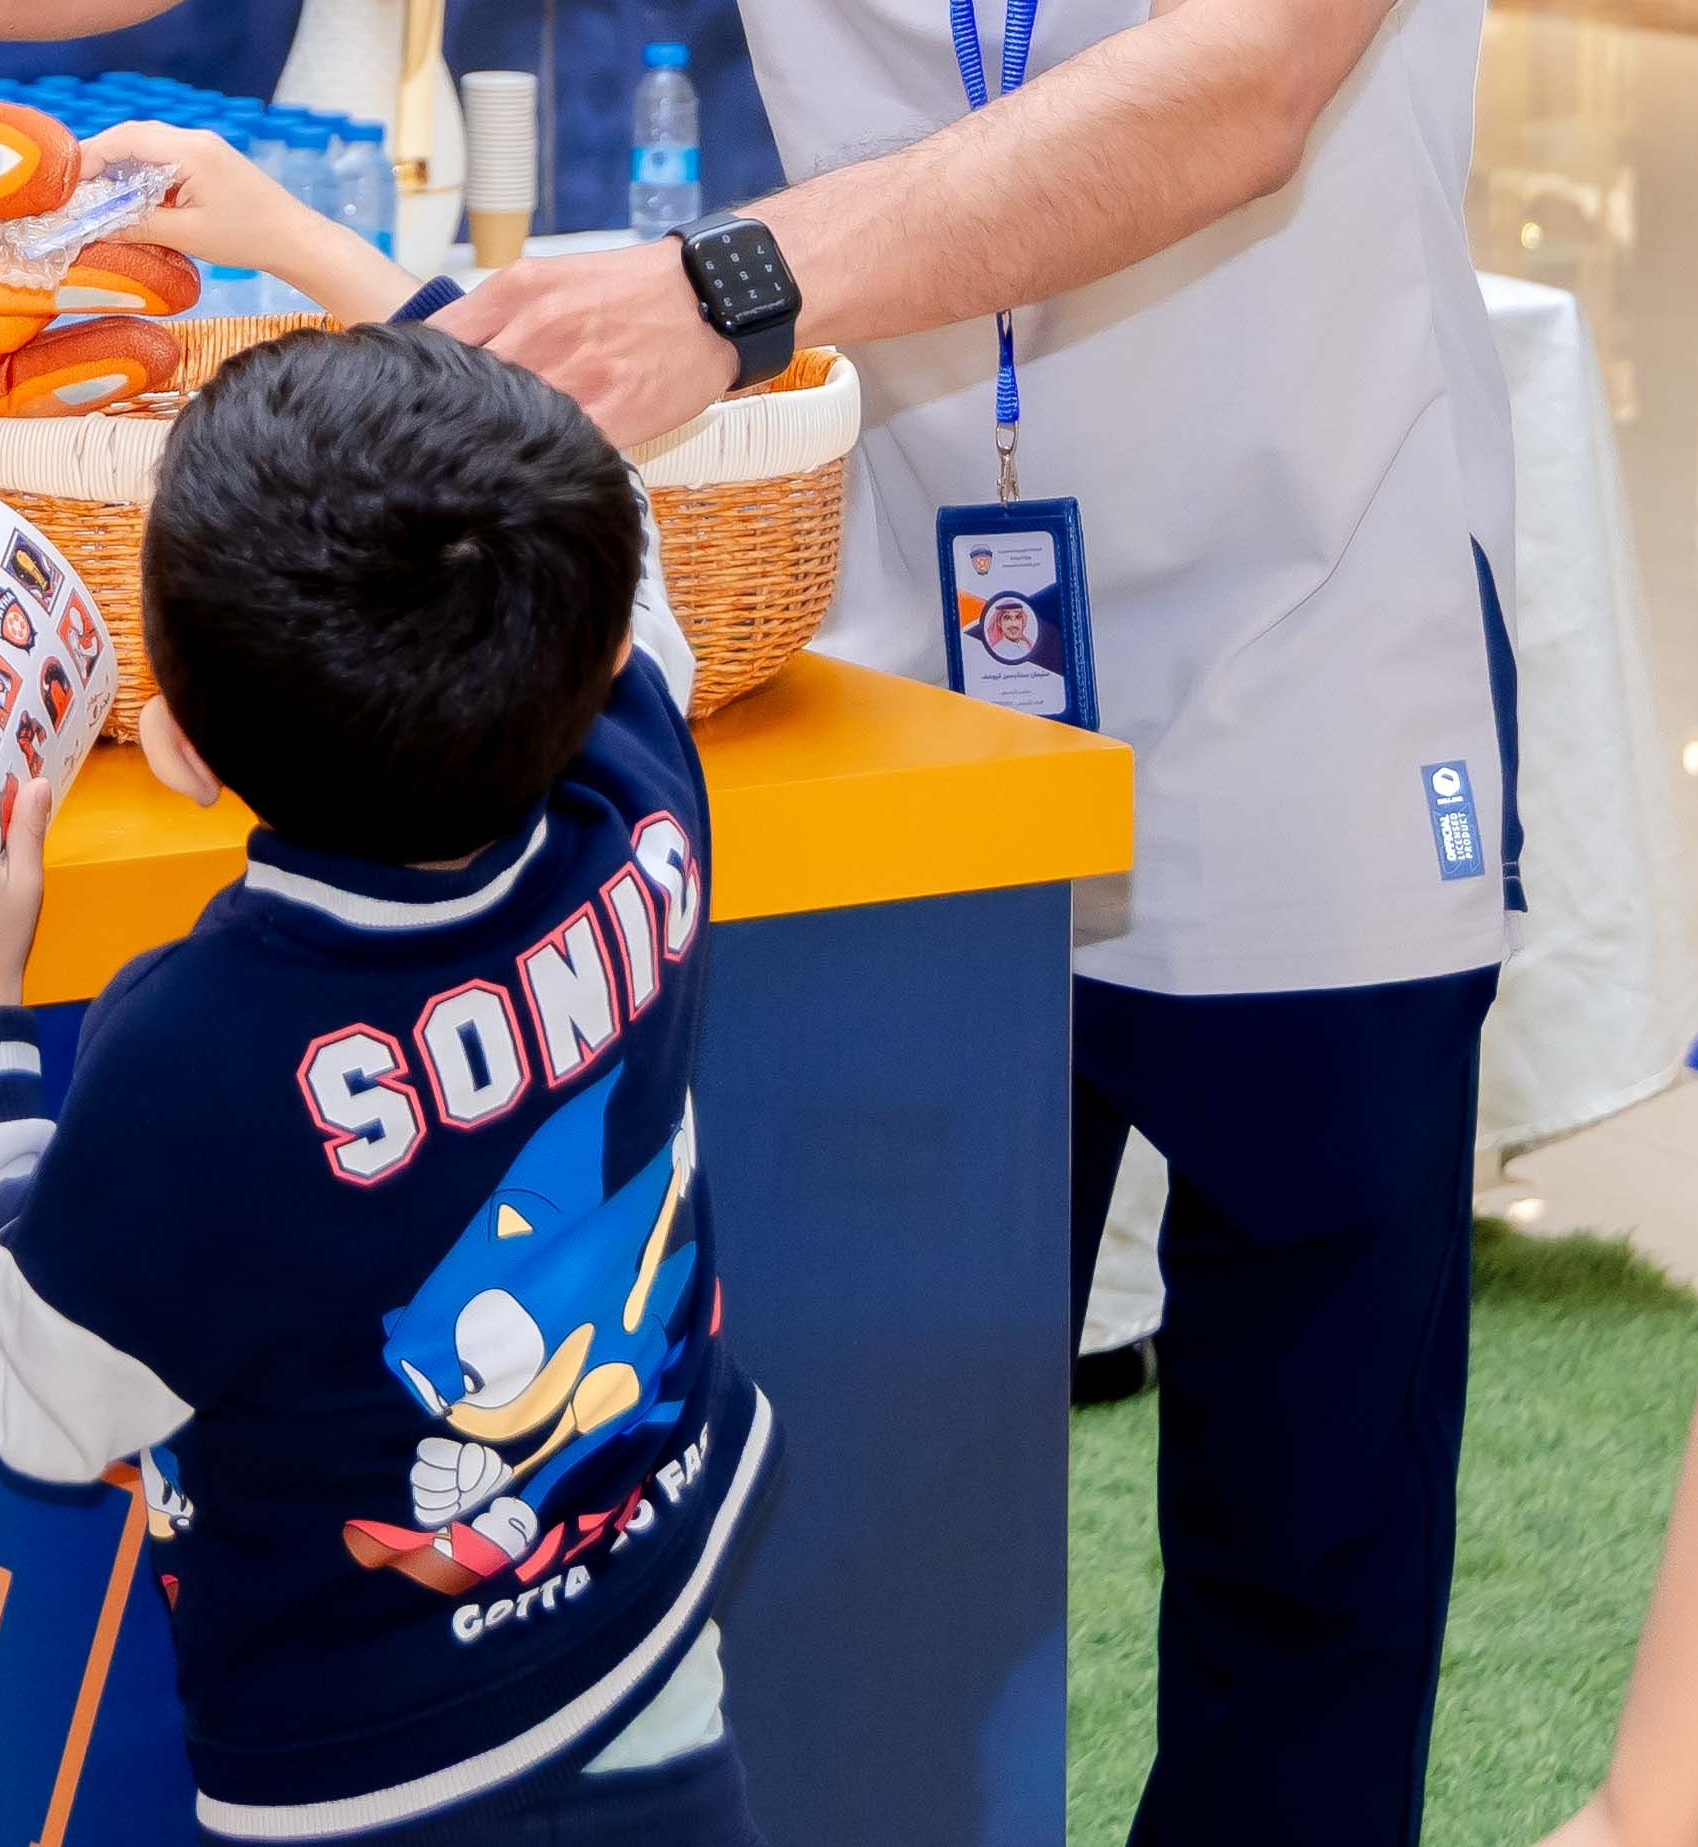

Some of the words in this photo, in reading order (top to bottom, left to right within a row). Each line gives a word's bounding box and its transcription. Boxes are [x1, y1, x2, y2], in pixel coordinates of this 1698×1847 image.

[1450, 812, 1466, 860] LICENSED
[1458, 811, 1474, 859] PRODUCT
[297, 809, 700, 1187] SONIC
